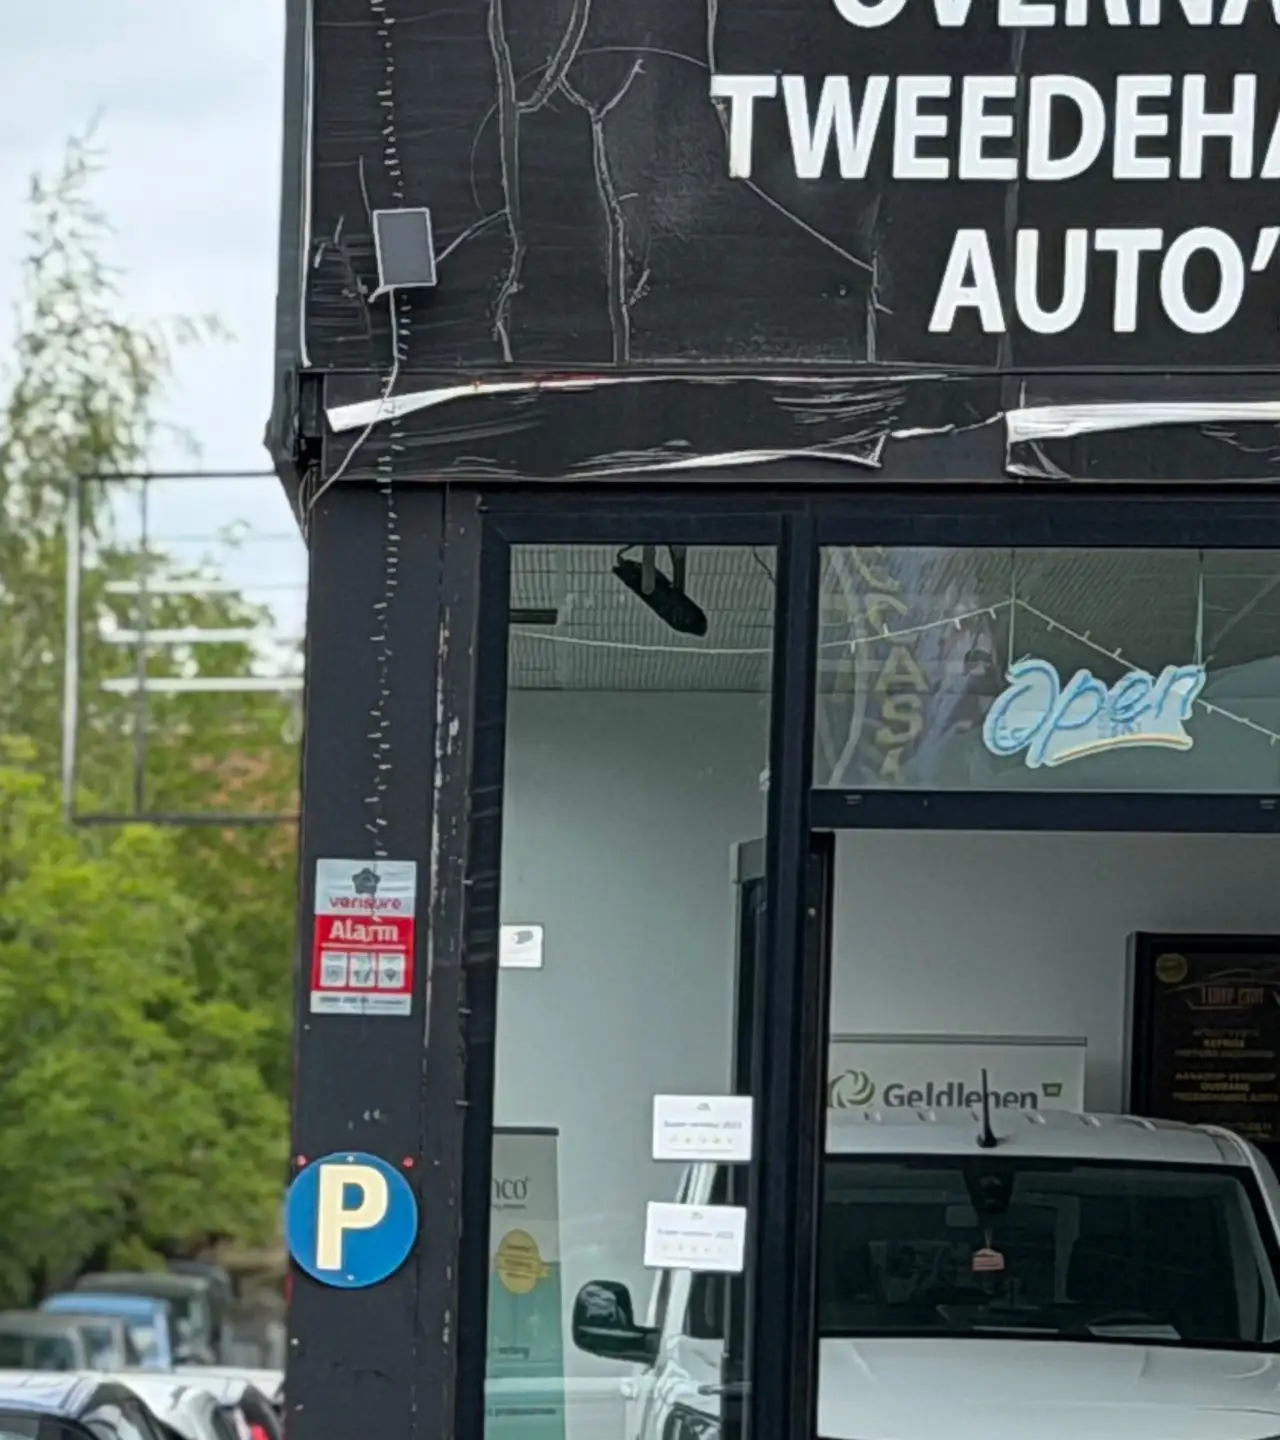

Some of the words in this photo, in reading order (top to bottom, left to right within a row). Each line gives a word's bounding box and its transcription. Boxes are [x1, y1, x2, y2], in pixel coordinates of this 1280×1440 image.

[710, 74, 1280, 180] TWEEDEH
[989, 663, 1204, 765] Open
[329, 918, 400, 943] Alarm
[316, 1163, 389, 1272] P
